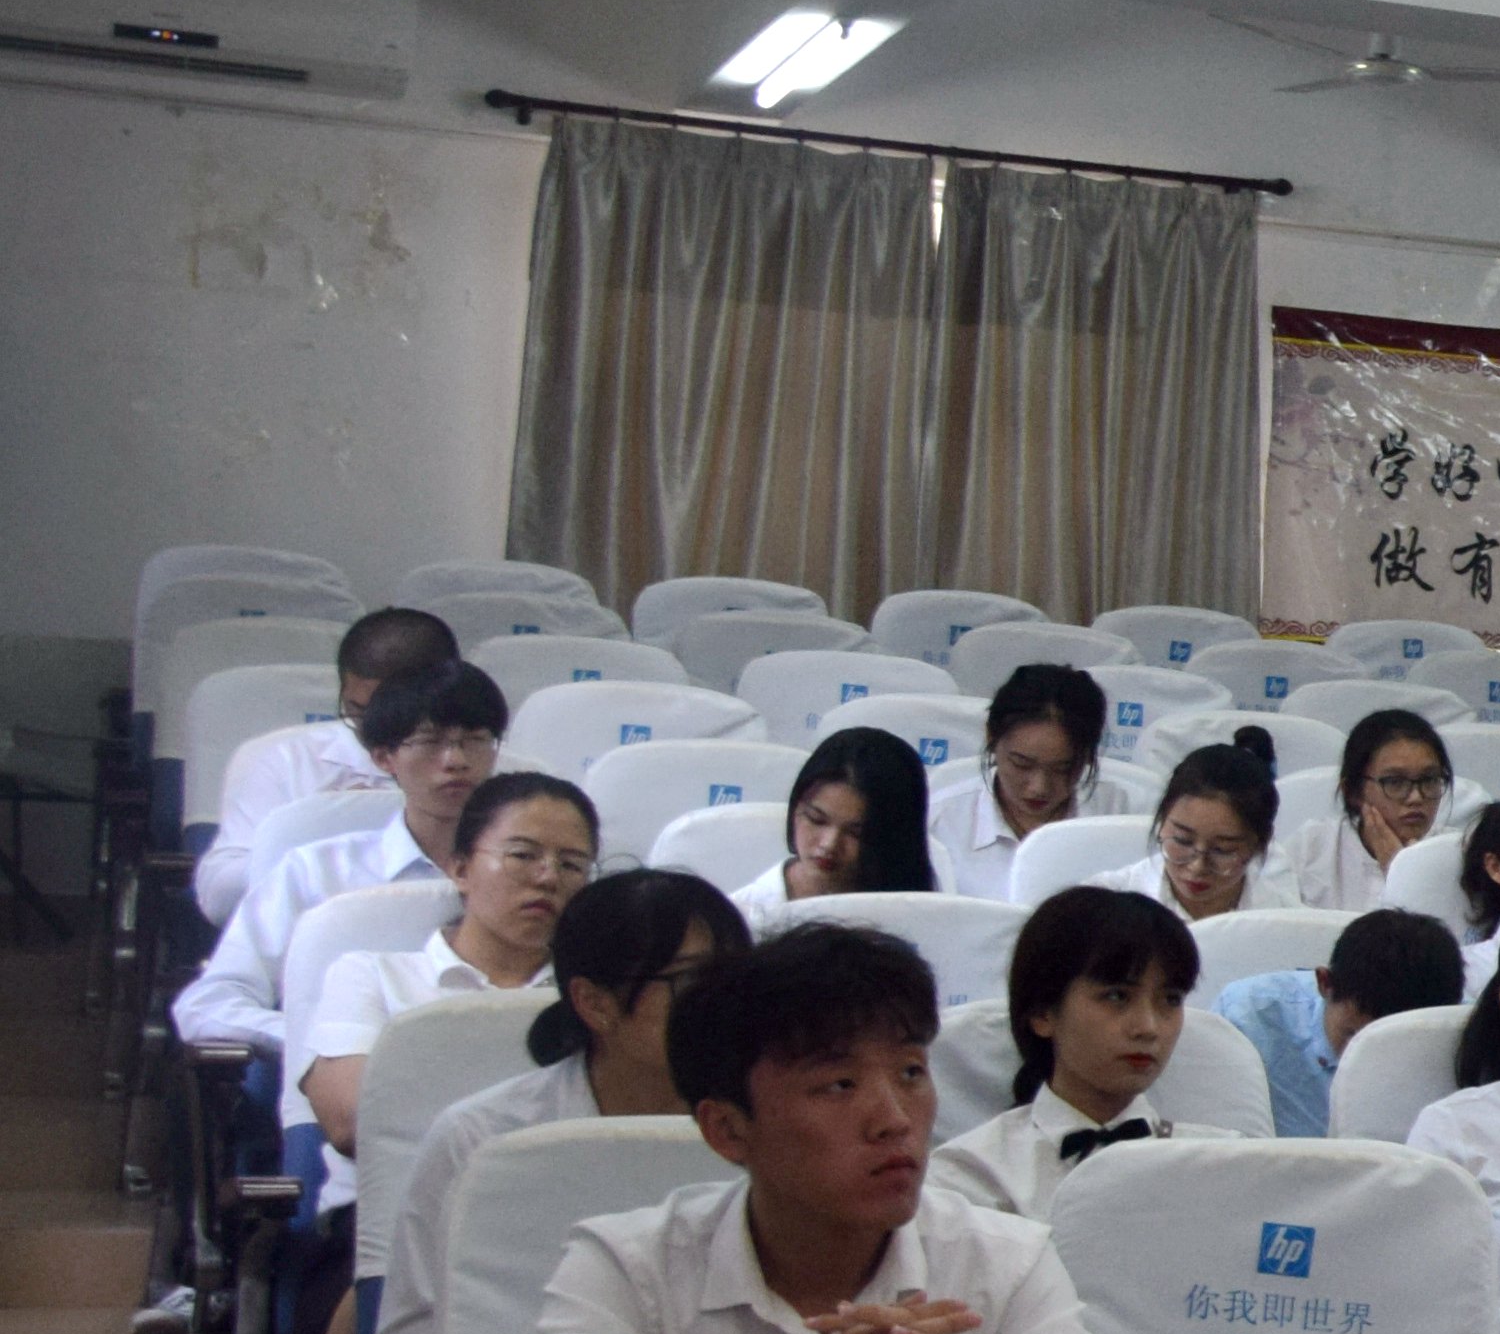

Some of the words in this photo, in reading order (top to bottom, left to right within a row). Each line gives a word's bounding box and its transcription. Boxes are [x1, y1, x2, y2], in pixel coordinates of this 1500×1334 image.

[1120, 703, 1140, 726] hp
[923, 739, 945, 765] hp
[1264, 1223, 1307, 1275] hp
